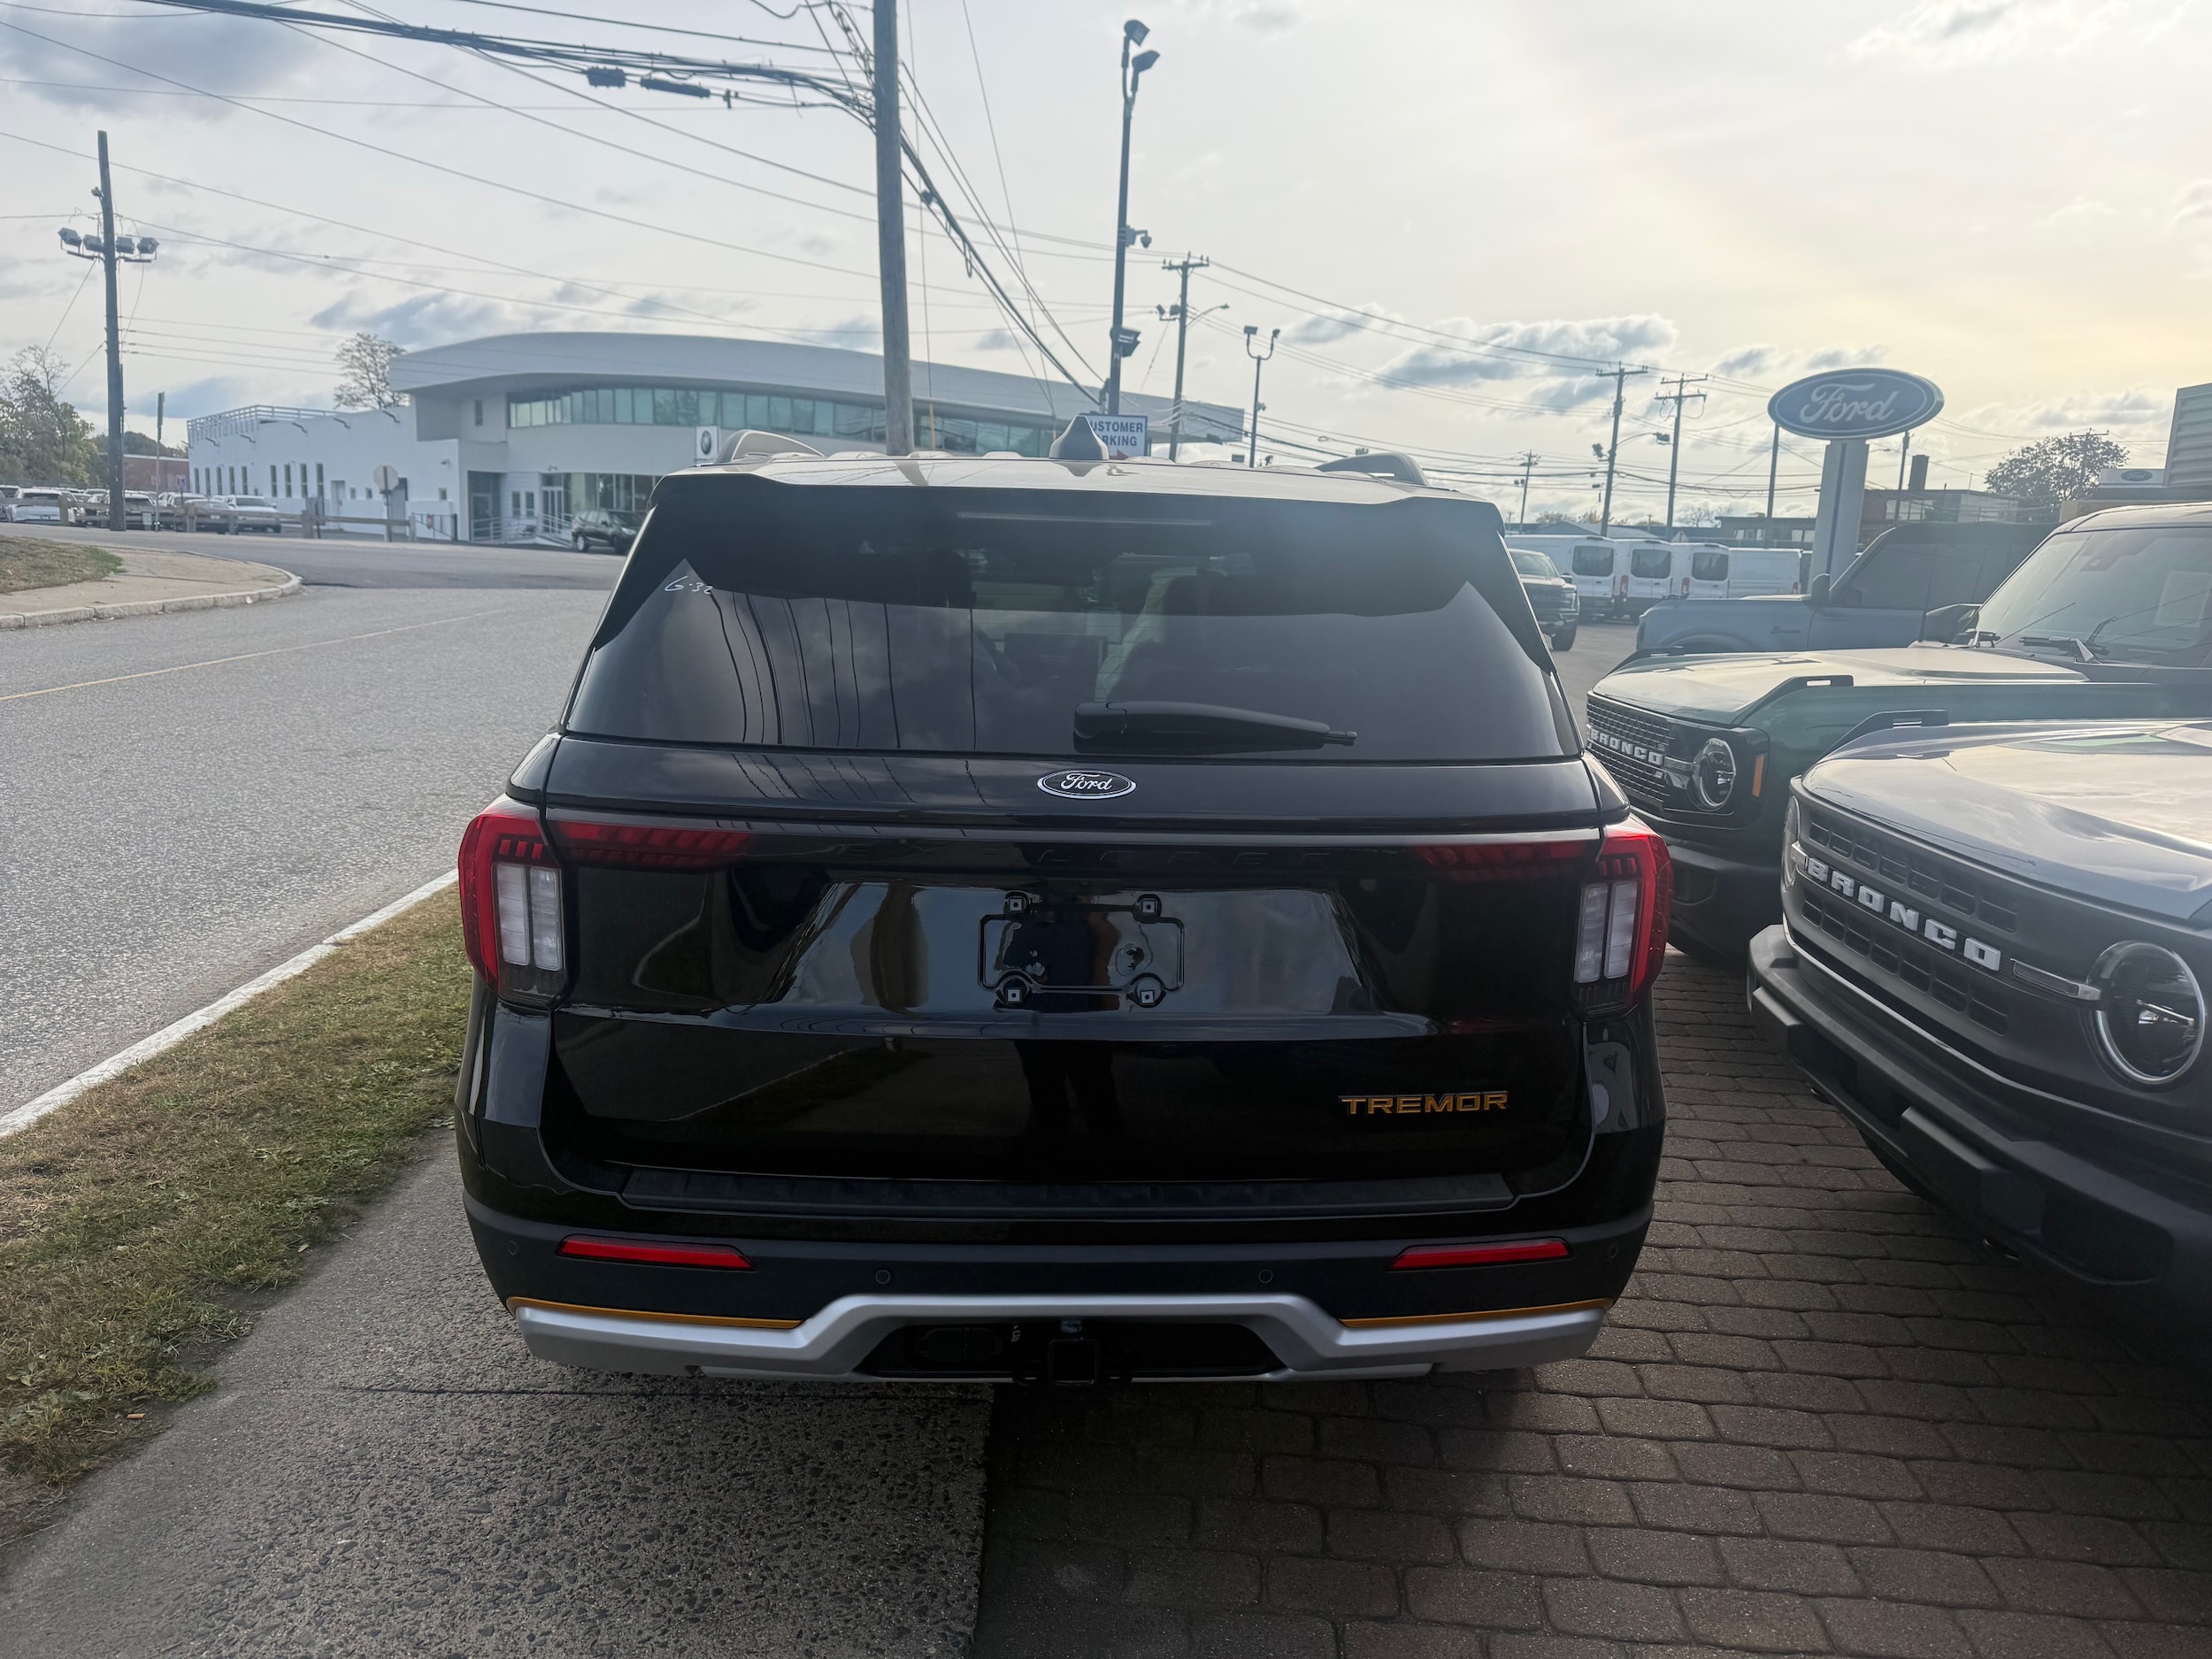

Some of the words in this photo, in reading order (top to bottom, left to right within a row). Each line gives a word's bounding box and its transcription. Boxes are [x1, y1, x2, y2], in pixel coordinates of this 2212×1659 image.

[1800, 382, 1900, 424] Ford
[1089, 420, 1143, 433] USTOMER
[1102, 434, 1137, 447] RKING
[1590, 727, 1663, 766] BRONCO
[1061, 772, 1113, 790] Ford
[1807, 857, 2001, 972] BRONCO
[1338, 1090, 1509, 1115] TREMOR
